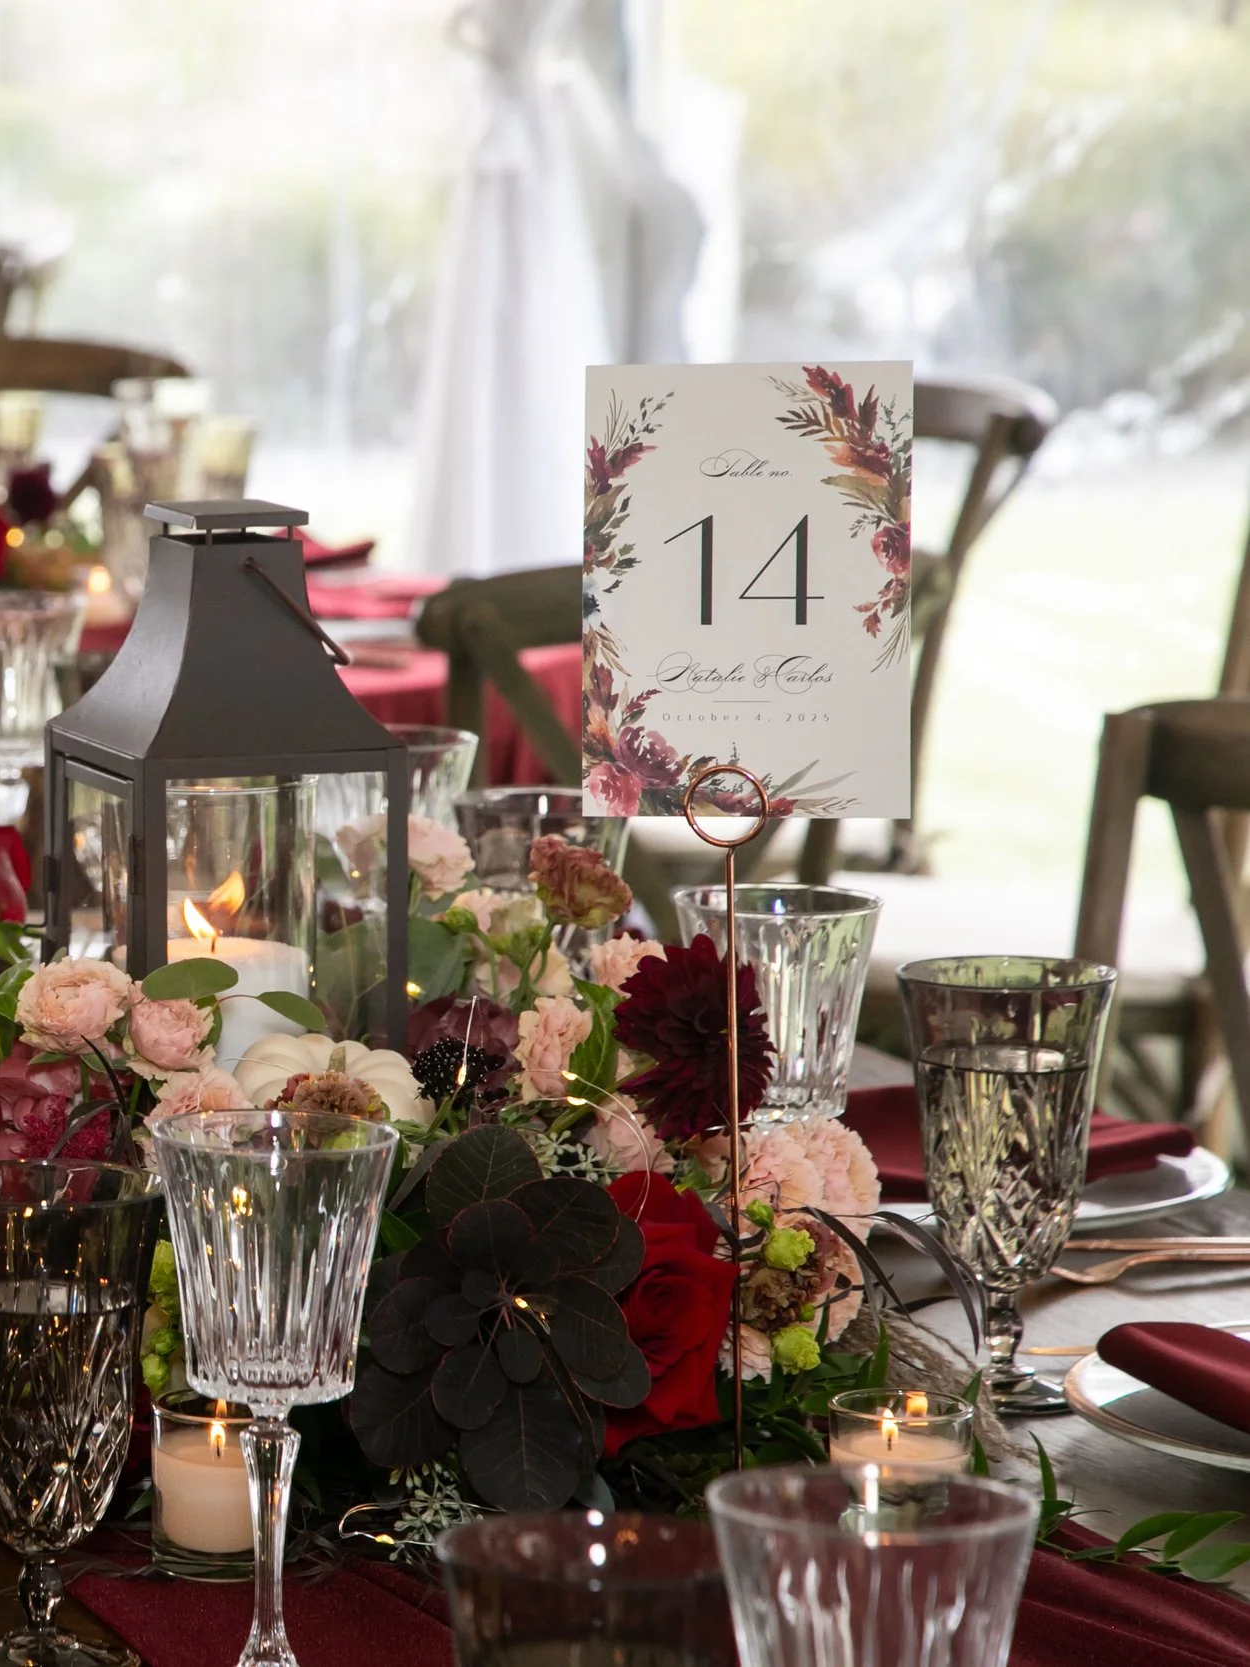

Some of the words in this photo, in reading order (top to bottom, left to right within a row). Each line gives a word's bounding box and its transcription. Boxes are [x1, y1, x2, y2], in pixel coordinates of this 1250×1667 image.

[699, 448, 770, 478] Table
[768, 469, 793, 478] no.
[663, 513, 825, 626] 14
[646, 652, 746, 694] Natalie
[754, 654, 835, 695] Carlos
[662, 711, 740, 723] October
[754, 711, 772, 724] 4,
[785, 711, 831, 723] 2025
